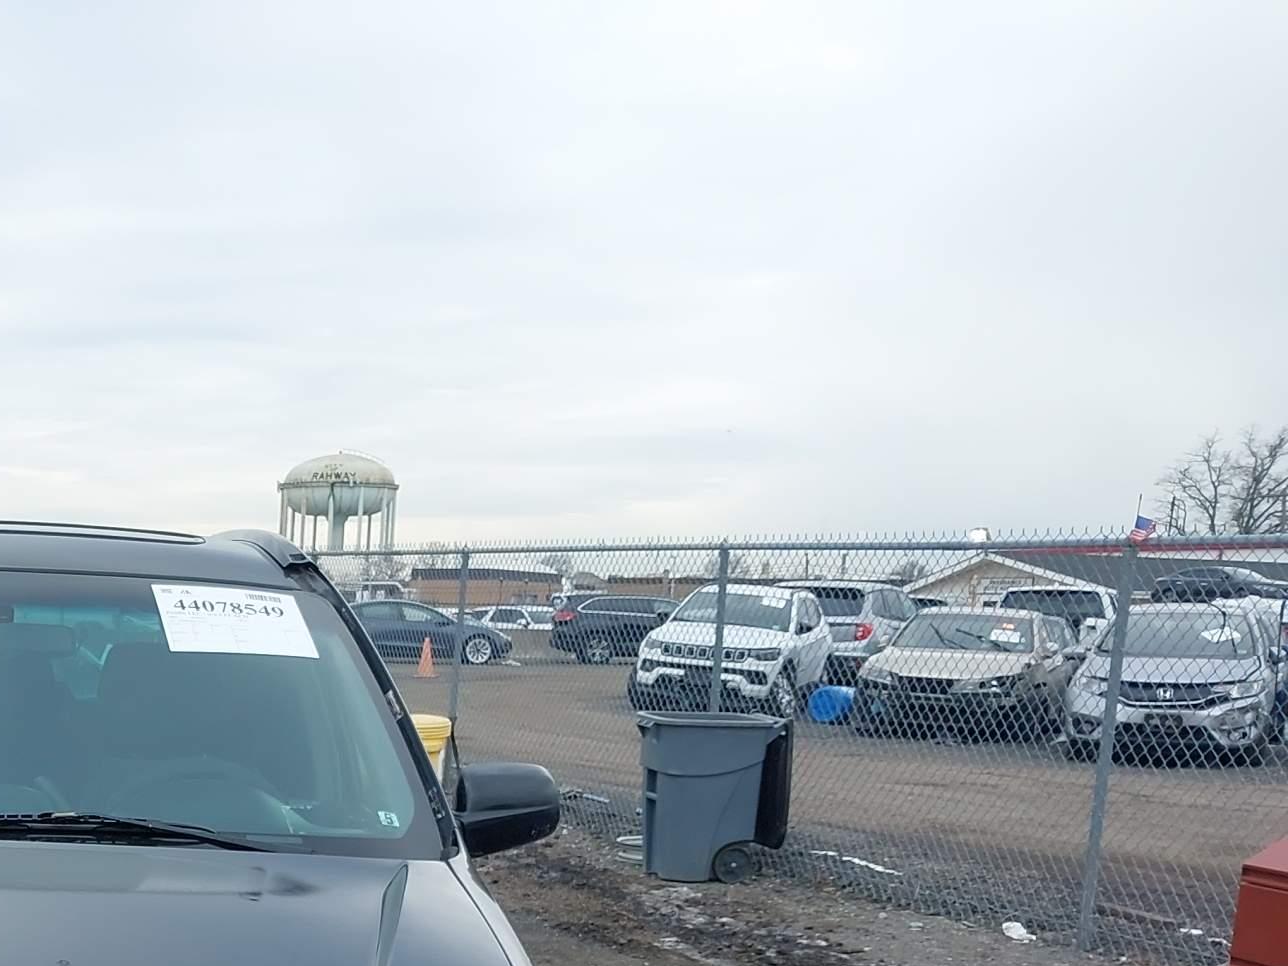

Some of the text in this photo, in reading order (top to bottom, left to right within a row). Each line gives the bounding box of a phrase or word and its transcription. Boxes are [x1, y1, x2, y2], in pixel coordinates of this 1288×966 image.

[312, 471, 357, 481] RAHWAY
[173, 598, 285, 618] 44078549
[384, 813, 394, 825] 5
